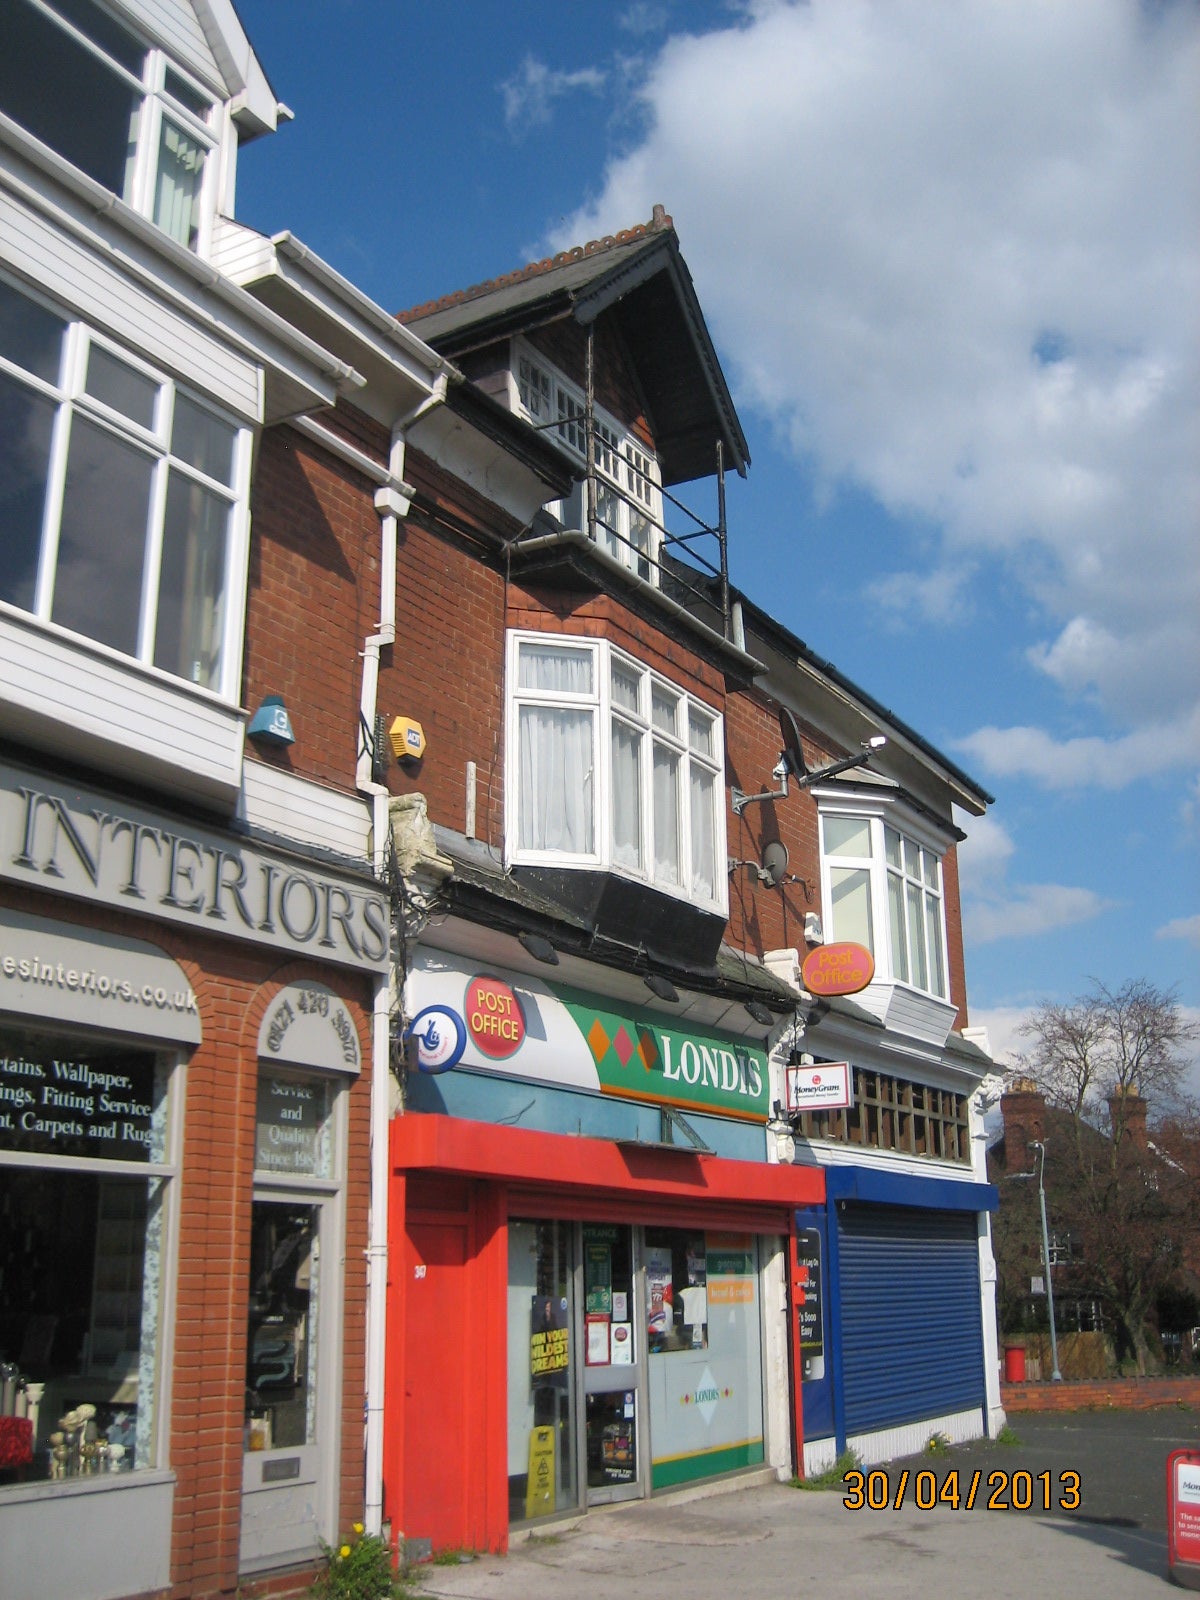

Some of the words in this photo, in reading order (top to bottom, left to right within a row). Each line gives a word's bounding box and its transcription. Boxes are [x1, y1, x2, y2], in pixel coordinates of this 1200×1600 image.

[407, 730, 420, 745] ADT
[12, 785, 389, 961] INTERIORS
[819, 950, 854, 968] Post
[2, 953, 198, 1015] esinteriors.co.uk
[811, 967, 863, 988] Office
[297, 988, 329, 1018] 420
[477, 988, 512, 1016] POST
[471, 1012, 519, 1042] OFFICE
[53, 1060, 133, 1091] Wallpaper,
[661, 1035, 762, 1098] LONDIS
[271, 1081, 314, 1100] Service
[794, 1083, 840, 1095] MoneyGram
[42, 1086, 94, 1116] Fitting
[280, 1105, 303, 1121] and
[21, 1111, 83, 1139] Carpets
[88, 1121, 117, 1139] and
[268, 1125, 311, 1146] Quality
[258, 1147, 291, 1165] Since
[695, 1389, 719, 1403] LONDIS
[1178, 1521, 1186, 1529] to
